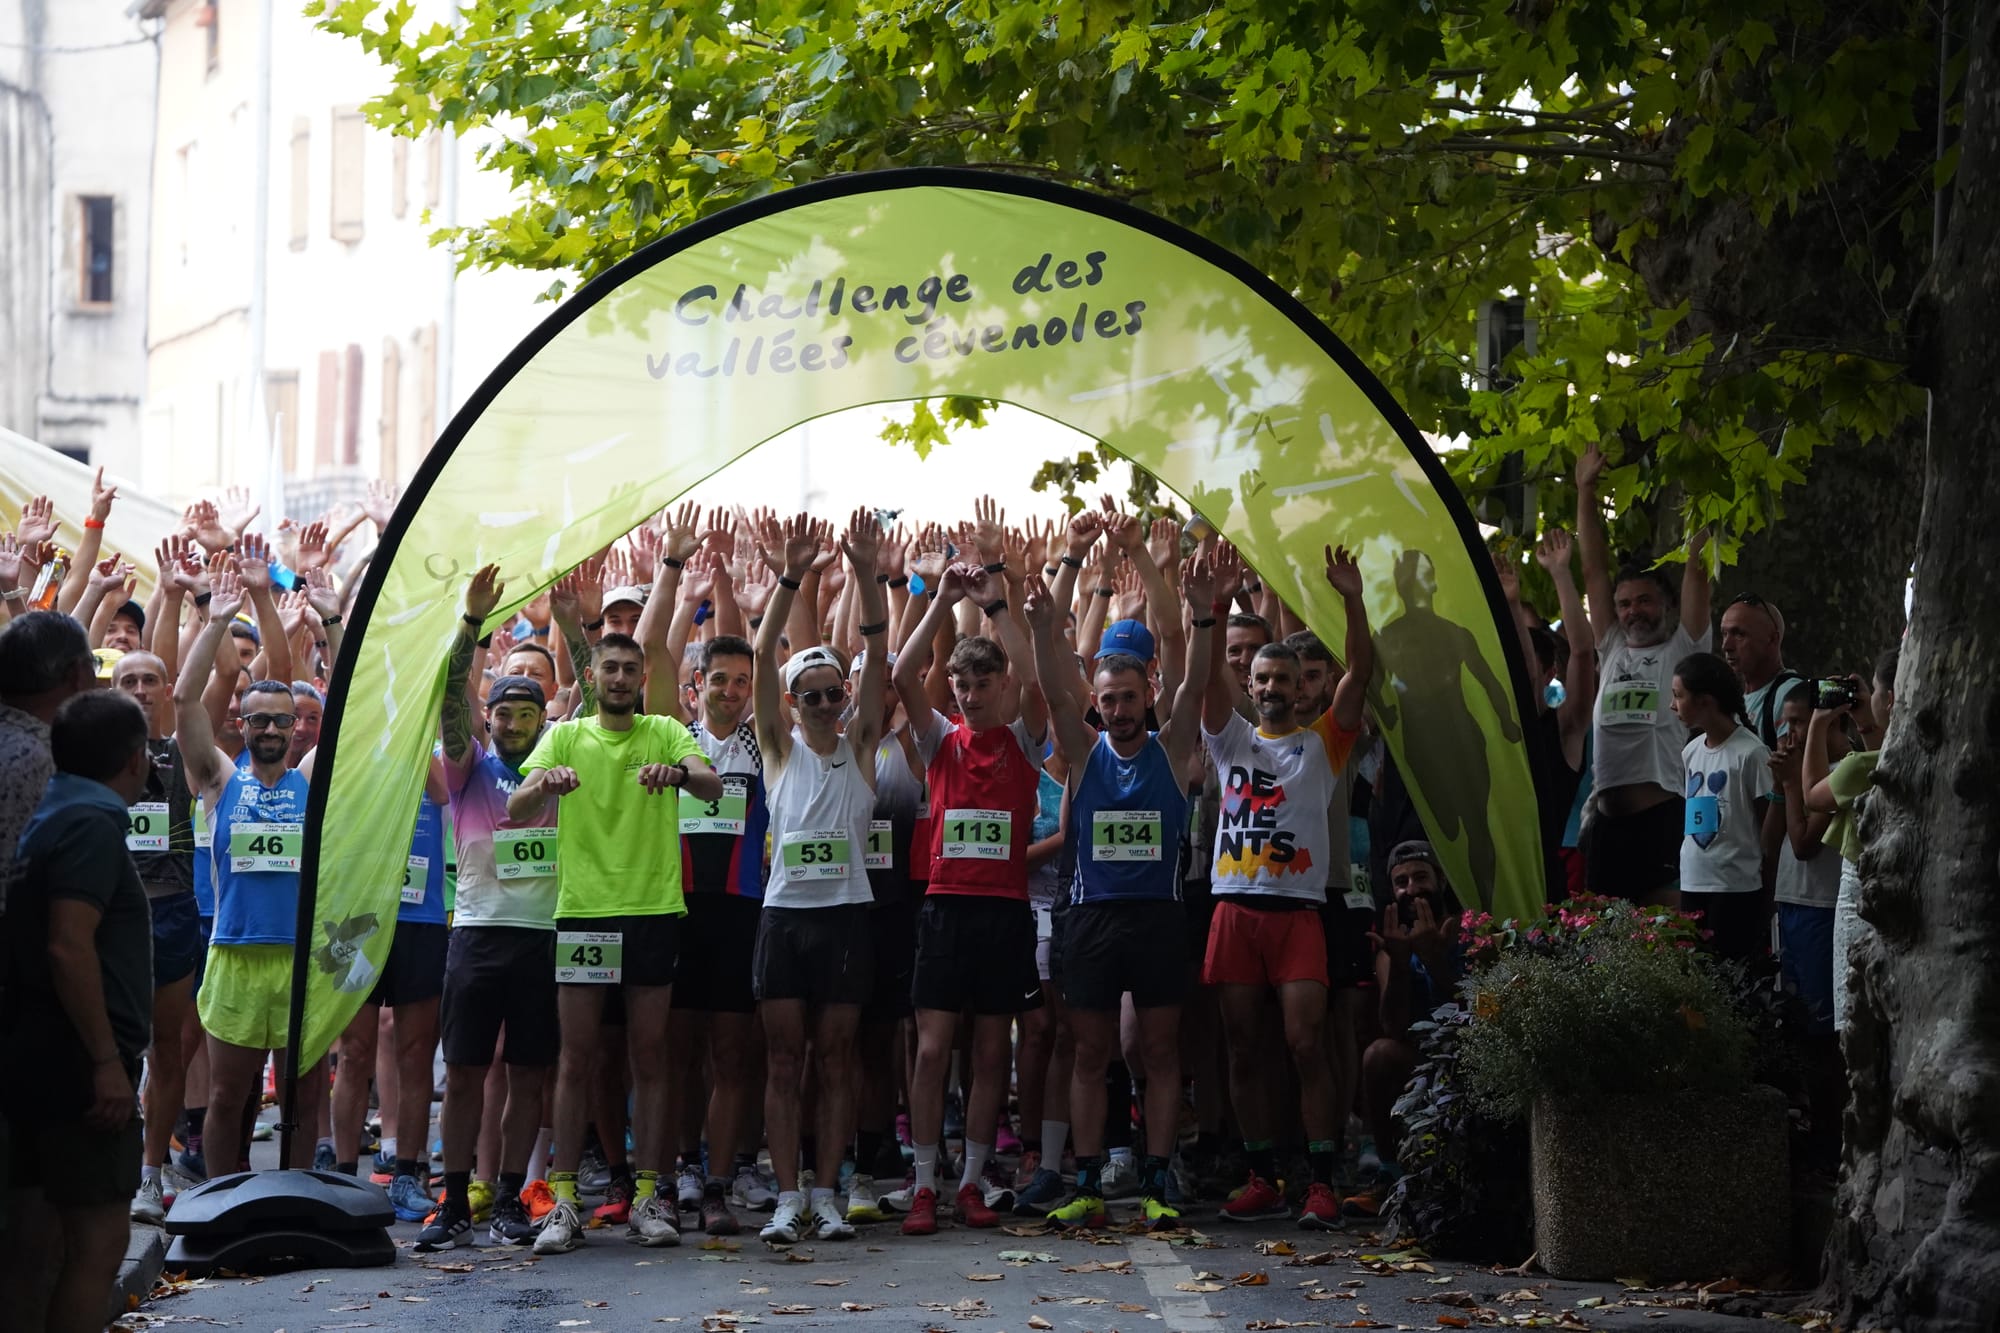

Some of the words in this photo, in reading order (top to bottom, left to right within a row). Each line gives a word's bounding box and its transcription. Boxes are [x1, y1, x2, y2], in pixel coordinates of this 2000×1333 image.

[674, 273, 973, 326] Challenge
[1012, 250, 1108, 293] des
[646, 331, 854, 380] vallées
[893, 300, 1147, 364] cévenoles
[1609, 691, 1650, 711] 117
[1226, 766, 1277, 796] DE
[704, 800, 720, 817] 3
[1222, 798, 1277, 829] ME
[1694, 811, 1703, 825] 5
[953, 821, 1002, 843] 113
[1103, 823, 1153, 844] 134
[248, 835, 284, 855] 46
[513, 841, 545, 861] 60
[800, 843, 833, 863] 53
[1219, 831, 1296, 863] NTS
[570, 945, 603, 966] 43
